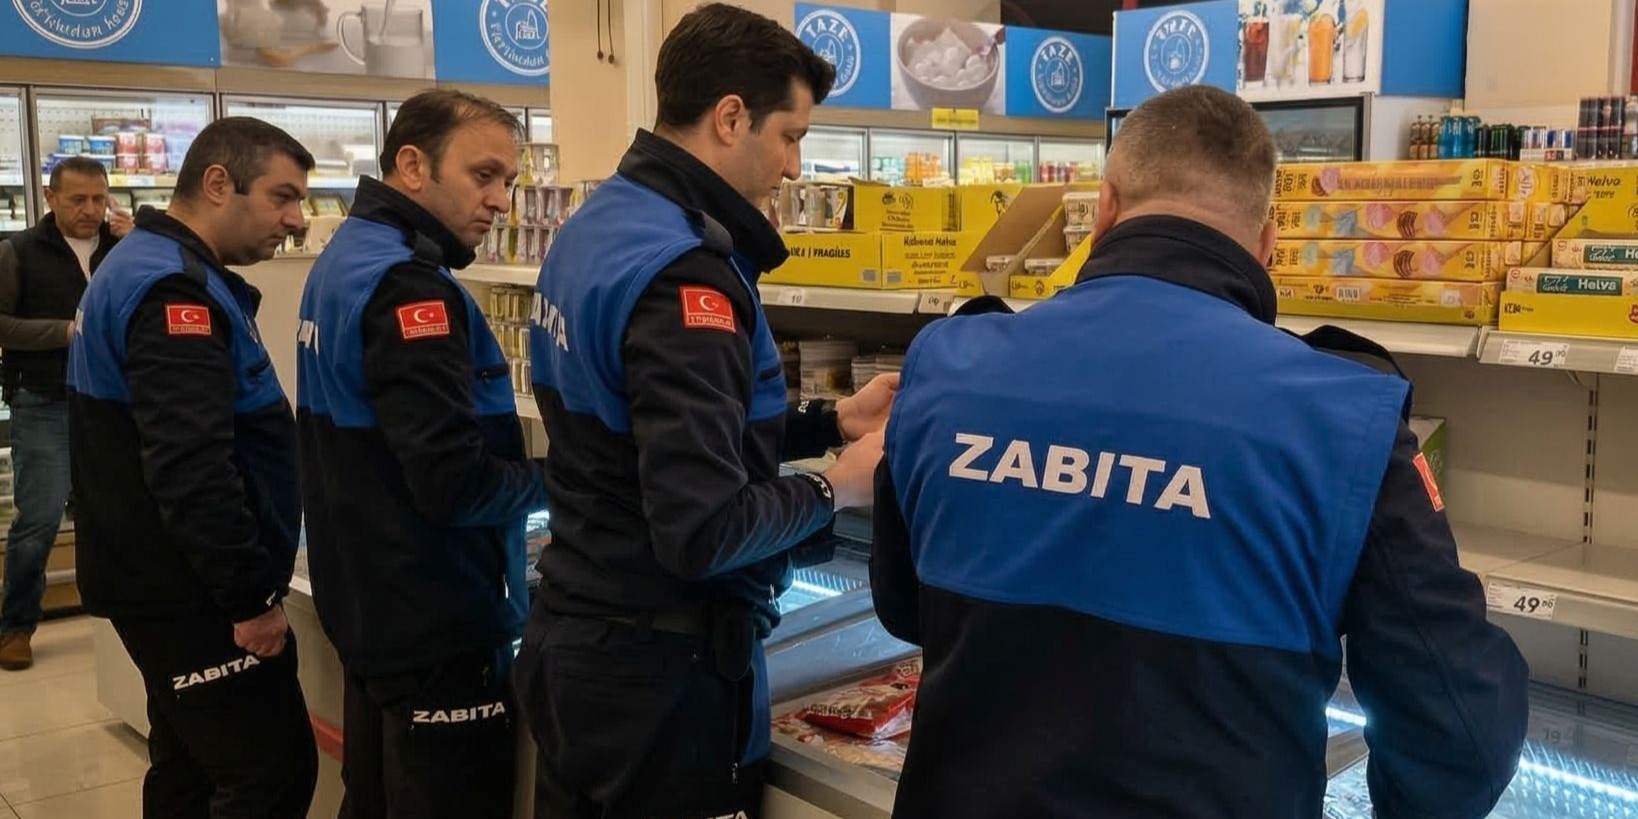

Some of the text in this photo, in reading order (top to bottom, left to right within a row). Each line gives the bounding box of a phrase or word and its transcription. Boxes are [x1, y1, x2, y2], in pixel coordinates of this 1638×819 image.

[805, 18, 848, 42] TAZE
[1041, 45, 1073, 65] TAZE
[1528, 350, 1553, 366] 49
[949, 432, 1211, 519] ZABITA
[1513, 595, 1540, 614] 49
[172, 654, 260, 691] ZABITA
[413, 701, 506, 724] ZABITA
